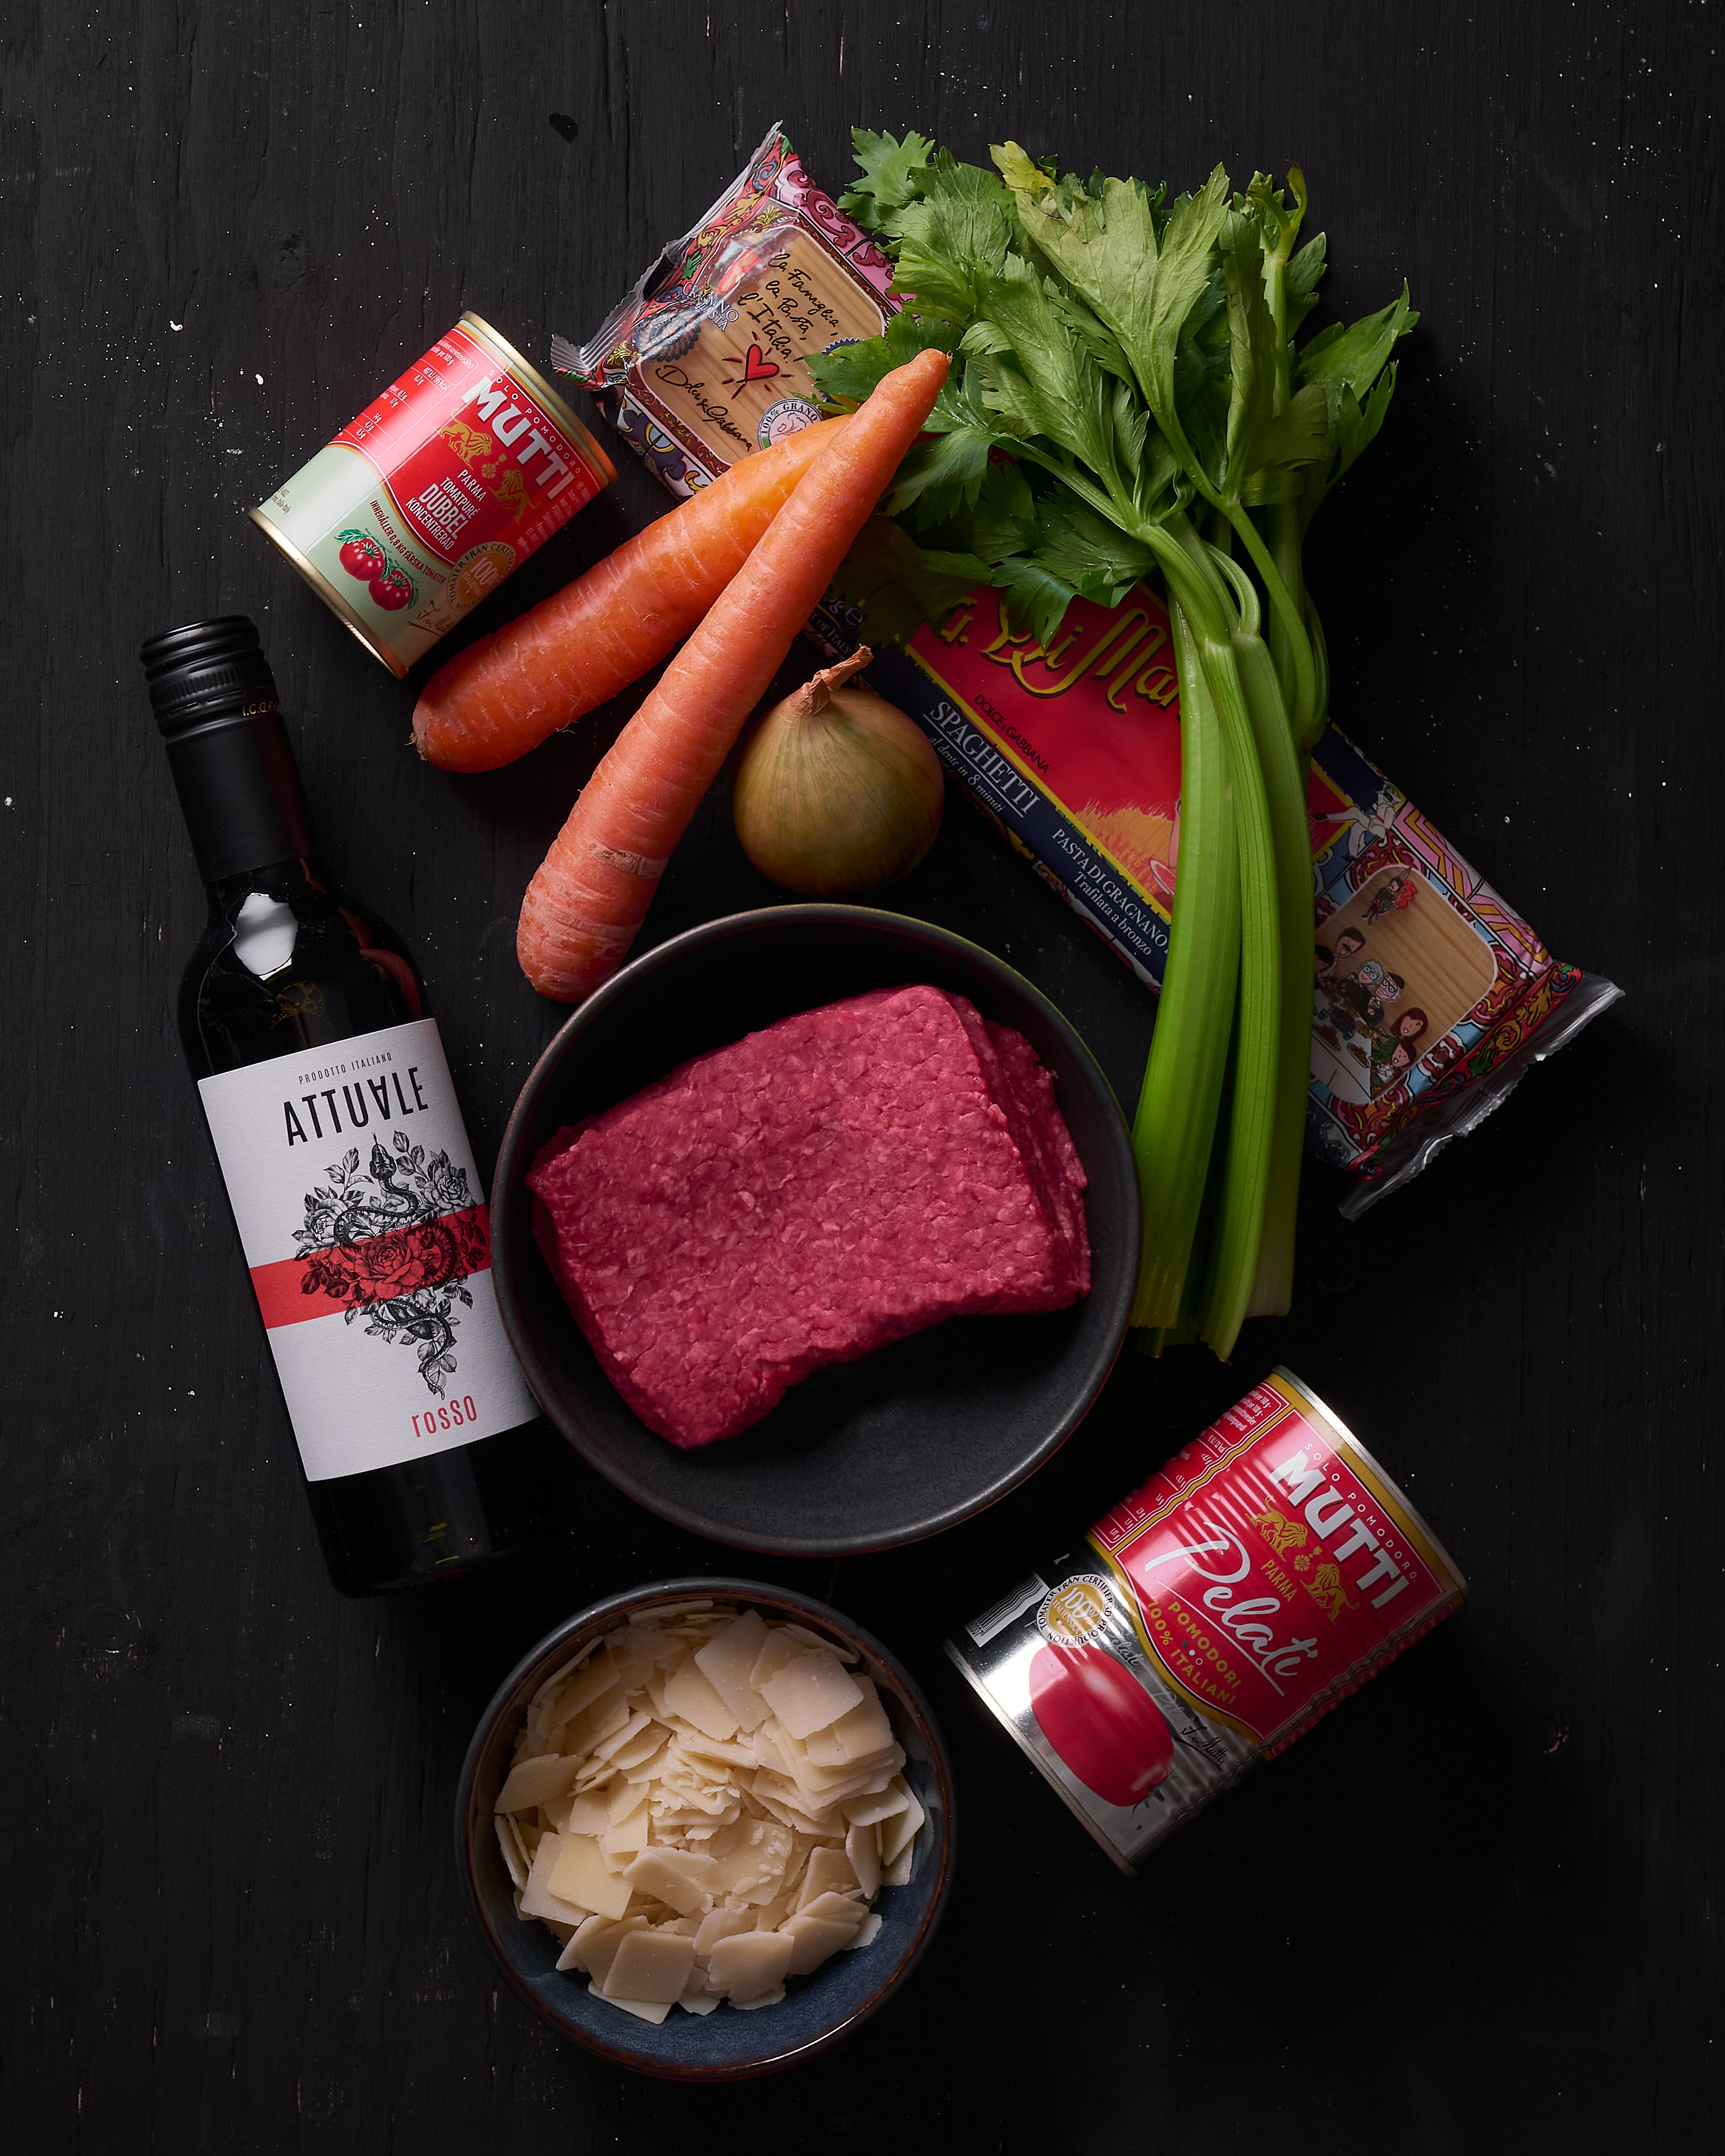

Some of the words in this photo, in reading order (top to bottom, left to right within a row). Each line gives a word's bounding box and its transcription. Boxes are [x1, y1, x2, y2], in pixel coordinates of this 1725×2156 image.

[487, 369, 520, 401] SOLO
[783, 403, 817, 420] GRANO
[460, 375, 575, 500] MUTTI
[439, 476, 480, 519] TOMATPURÉ
[456, 468, 488, 502] PARMA
[404, 497, 456, 551] KONCENTRERAD
[417, 482, 472, 539] DUBBEL
[369, 499, 393, 536] INNEHÅLLER
[395, 542, 406, 554] KG
[421, 566, 447, 584] TOMATER
[448, 561, 465, 602] TOMATER
[928, 699, 1040, 814] SPAGHETTI
[937, 741, 962, 767] dente
[956, 762, 972, 778] in
[966, 771, 982, 787] 8
[974, 782, 1006, 814] minuti
[1050, 828, 1093, 870] PASTA
[1086, 863, 1106, 885] DI
[1100, 877, 1170, 950] GRAGNANO
[1073, 870, 1116, 917] Trafilata
[1110, 912, 1121, 924] a
[1117, 918, 1154, 957] bronzo
[298, 1063, 346, 1084] PRODOTTO
[350, 1052, 392, 1071] ITALIANO
[283, 1066, 429, 1146] ATTUALE
[1303, 1442, 1340, 1482] SOLO
[1267, 1449, 1410, 1610] MUTTI
[1082, 1575, 1113, 1616] CERTIFIERAD
[1145, 1522, 1316, 1677] Pelati
[1259, 1559, 1296, 1602] PARMA
[1037, 1590, 1057, 1630] TOMATER
[1052, 1599, 1079, 1634] ITALIENSKA
[1061, 1587, 1098, 1625] 100%
[1047, 1619, 1106, 1645] PRODUKTION
[1147, 1601, 1173, 1644] 100%
[1170, 1648, 1236, 1705] ITALIANI
[1168, 1600, 1241, 1689] POMODORI
